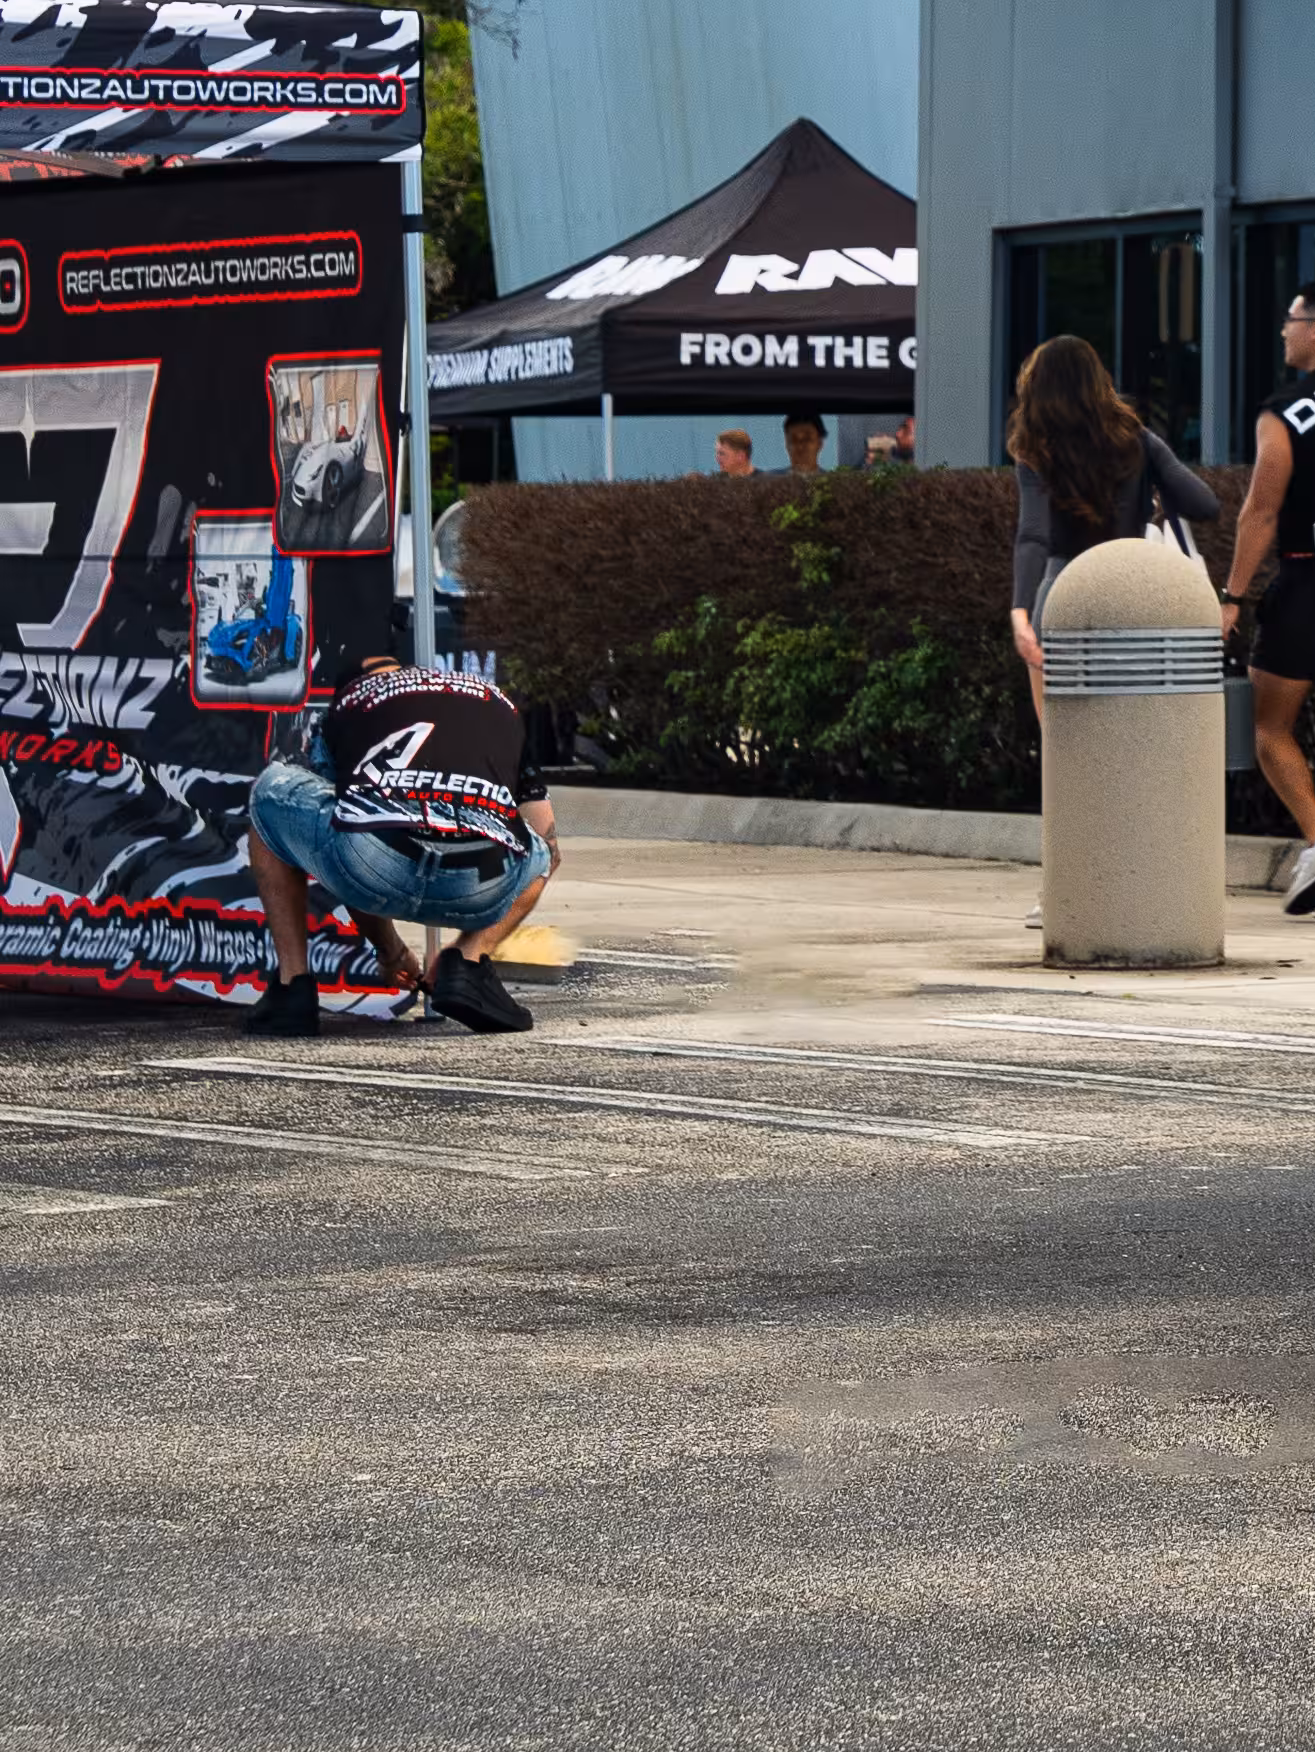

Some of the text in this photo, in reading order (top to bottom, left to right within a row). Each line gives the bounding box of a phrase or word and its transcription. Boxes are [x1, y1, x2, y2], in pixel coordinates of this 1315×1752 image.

[66, 252, 355, 295] REFLECTIONZAUTOWORKS.COM
[680, 332, 798, 368] FROM
[807, 335, 890, 368] THE
[407, 790, 453, 803] AUTO
[0, 916, 57, 958] ramic
[60, 916, 141, 972] Coating
[147, 919, 196, 973] Vinyl
[200, 920, 256, 976] Wraps
